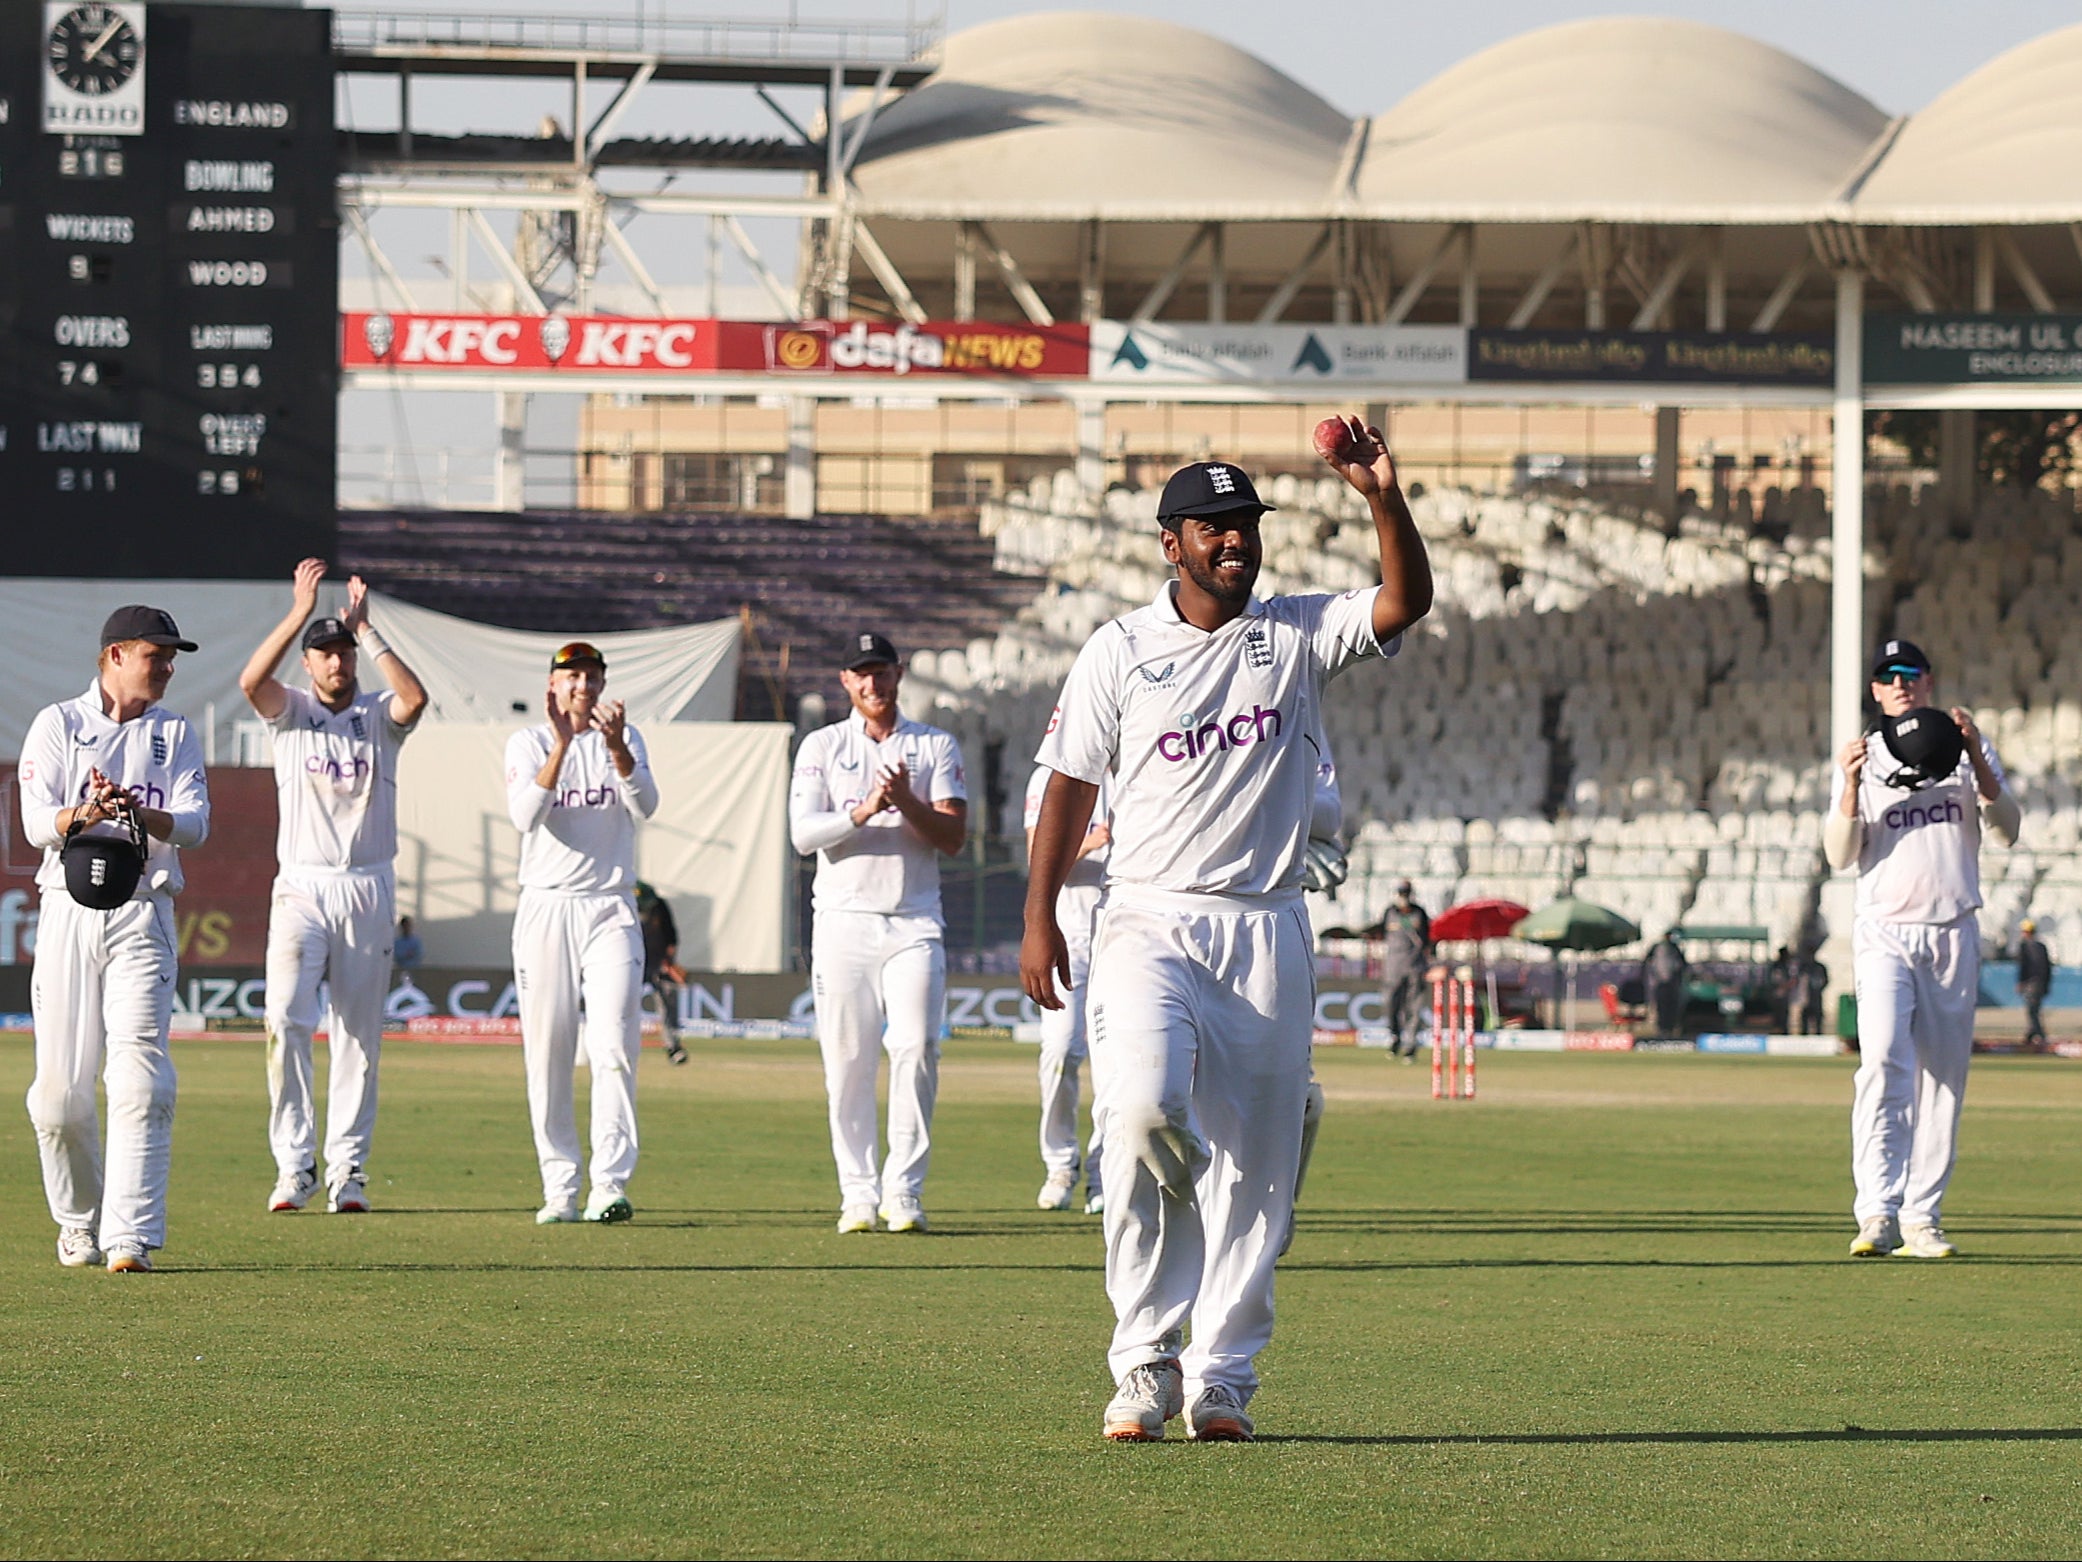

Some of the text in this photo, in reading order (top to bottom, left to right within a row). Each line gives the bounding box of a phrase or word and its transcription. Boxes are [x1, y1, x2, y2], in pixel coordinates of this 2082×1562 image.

[174, 100, 289, 128] ENGLAND
[184, 159, 274, 192] BOWLING
[46, 213, 134, 243] WICKETS
[187, 206, 275, 232] AHMED
[189, 260, 267, 286] WOOD
[55, 315, 130, 347] OVERS
[401, 319, 521, 364] KFC
[576, 322, 696, 367] KFC
[1901, 323, 2021, 350] NASEEM
[2029, 323, 2068, 350] UL
[57, 361, 98, 385] 74
[38, 421, 97, 452] LAST
[205, 434, 259, 456] LEFT
[1157, 704, 1281, 762] cinch
[306, 747, 370, 779] cinch
[1886, 801, 1963, 829] cinch
